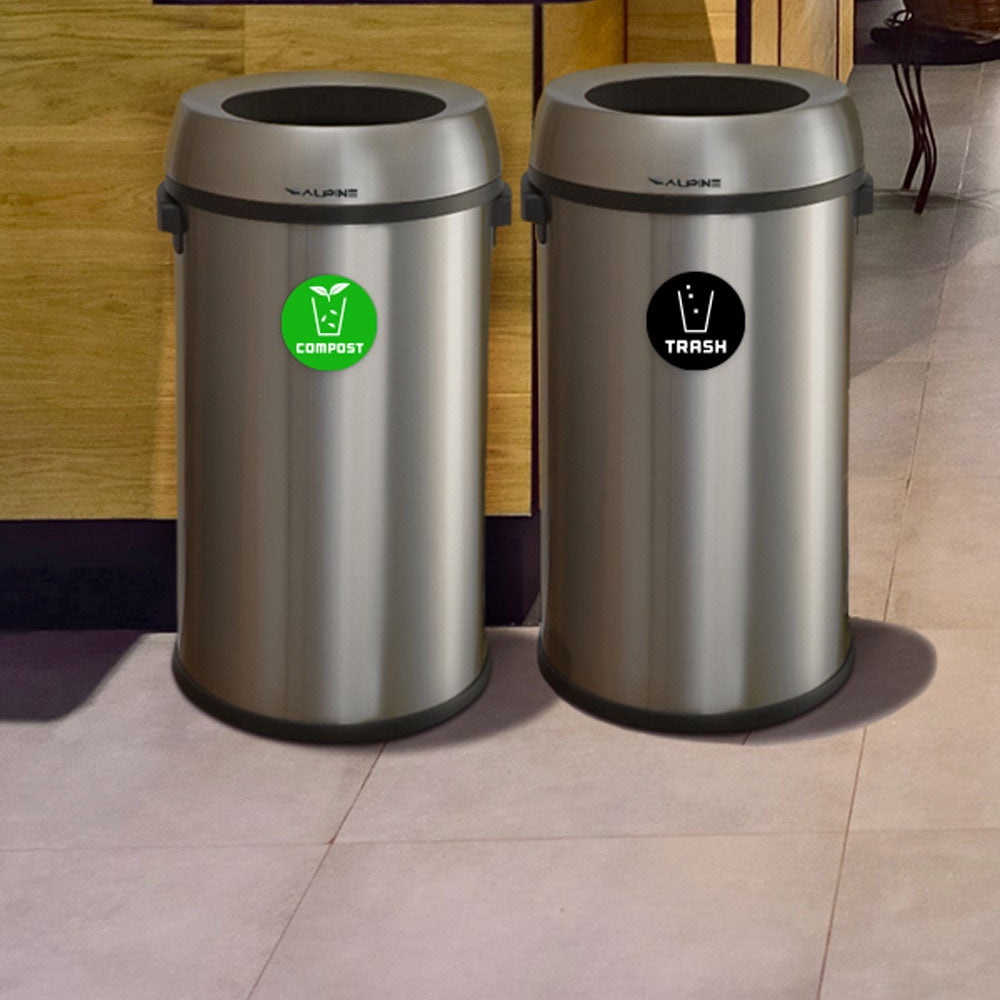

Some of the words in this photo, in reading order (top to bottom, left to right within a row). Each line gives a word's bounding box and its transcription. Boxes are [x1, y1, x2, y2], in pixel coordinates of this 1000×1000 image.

[664, 178, 721, 188] ALPINE
[300, 188, 358, 198] ALPINE
[296, 342, 364, 354] COMPOST
[665, 339, 727, 354] TRASH
